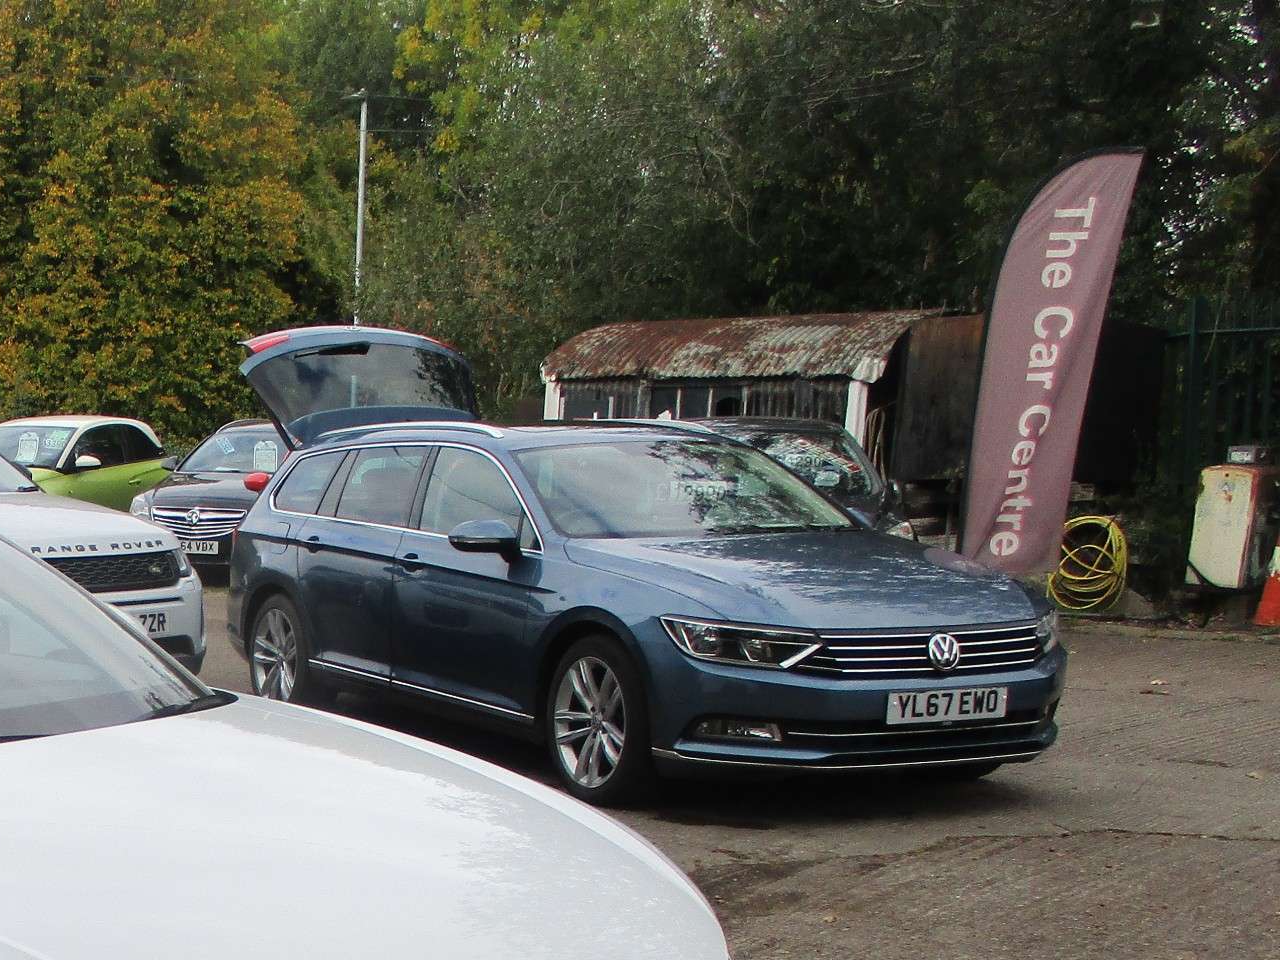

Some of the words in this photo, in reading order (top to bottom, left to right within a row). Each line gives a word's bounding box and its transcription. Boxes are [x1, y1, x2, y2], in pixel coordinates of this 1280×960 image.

[1040, 196, 1096, 289] The
[1026, 306, 1074, 390] Car
[989, 404, 1052, 557] Centre
[30, 544, 99, 555] RANGE
[110, 539, 165, 551] ROVER
[897, 692, 954, 719] YL67
[958, 689, 999, 716] EWO
